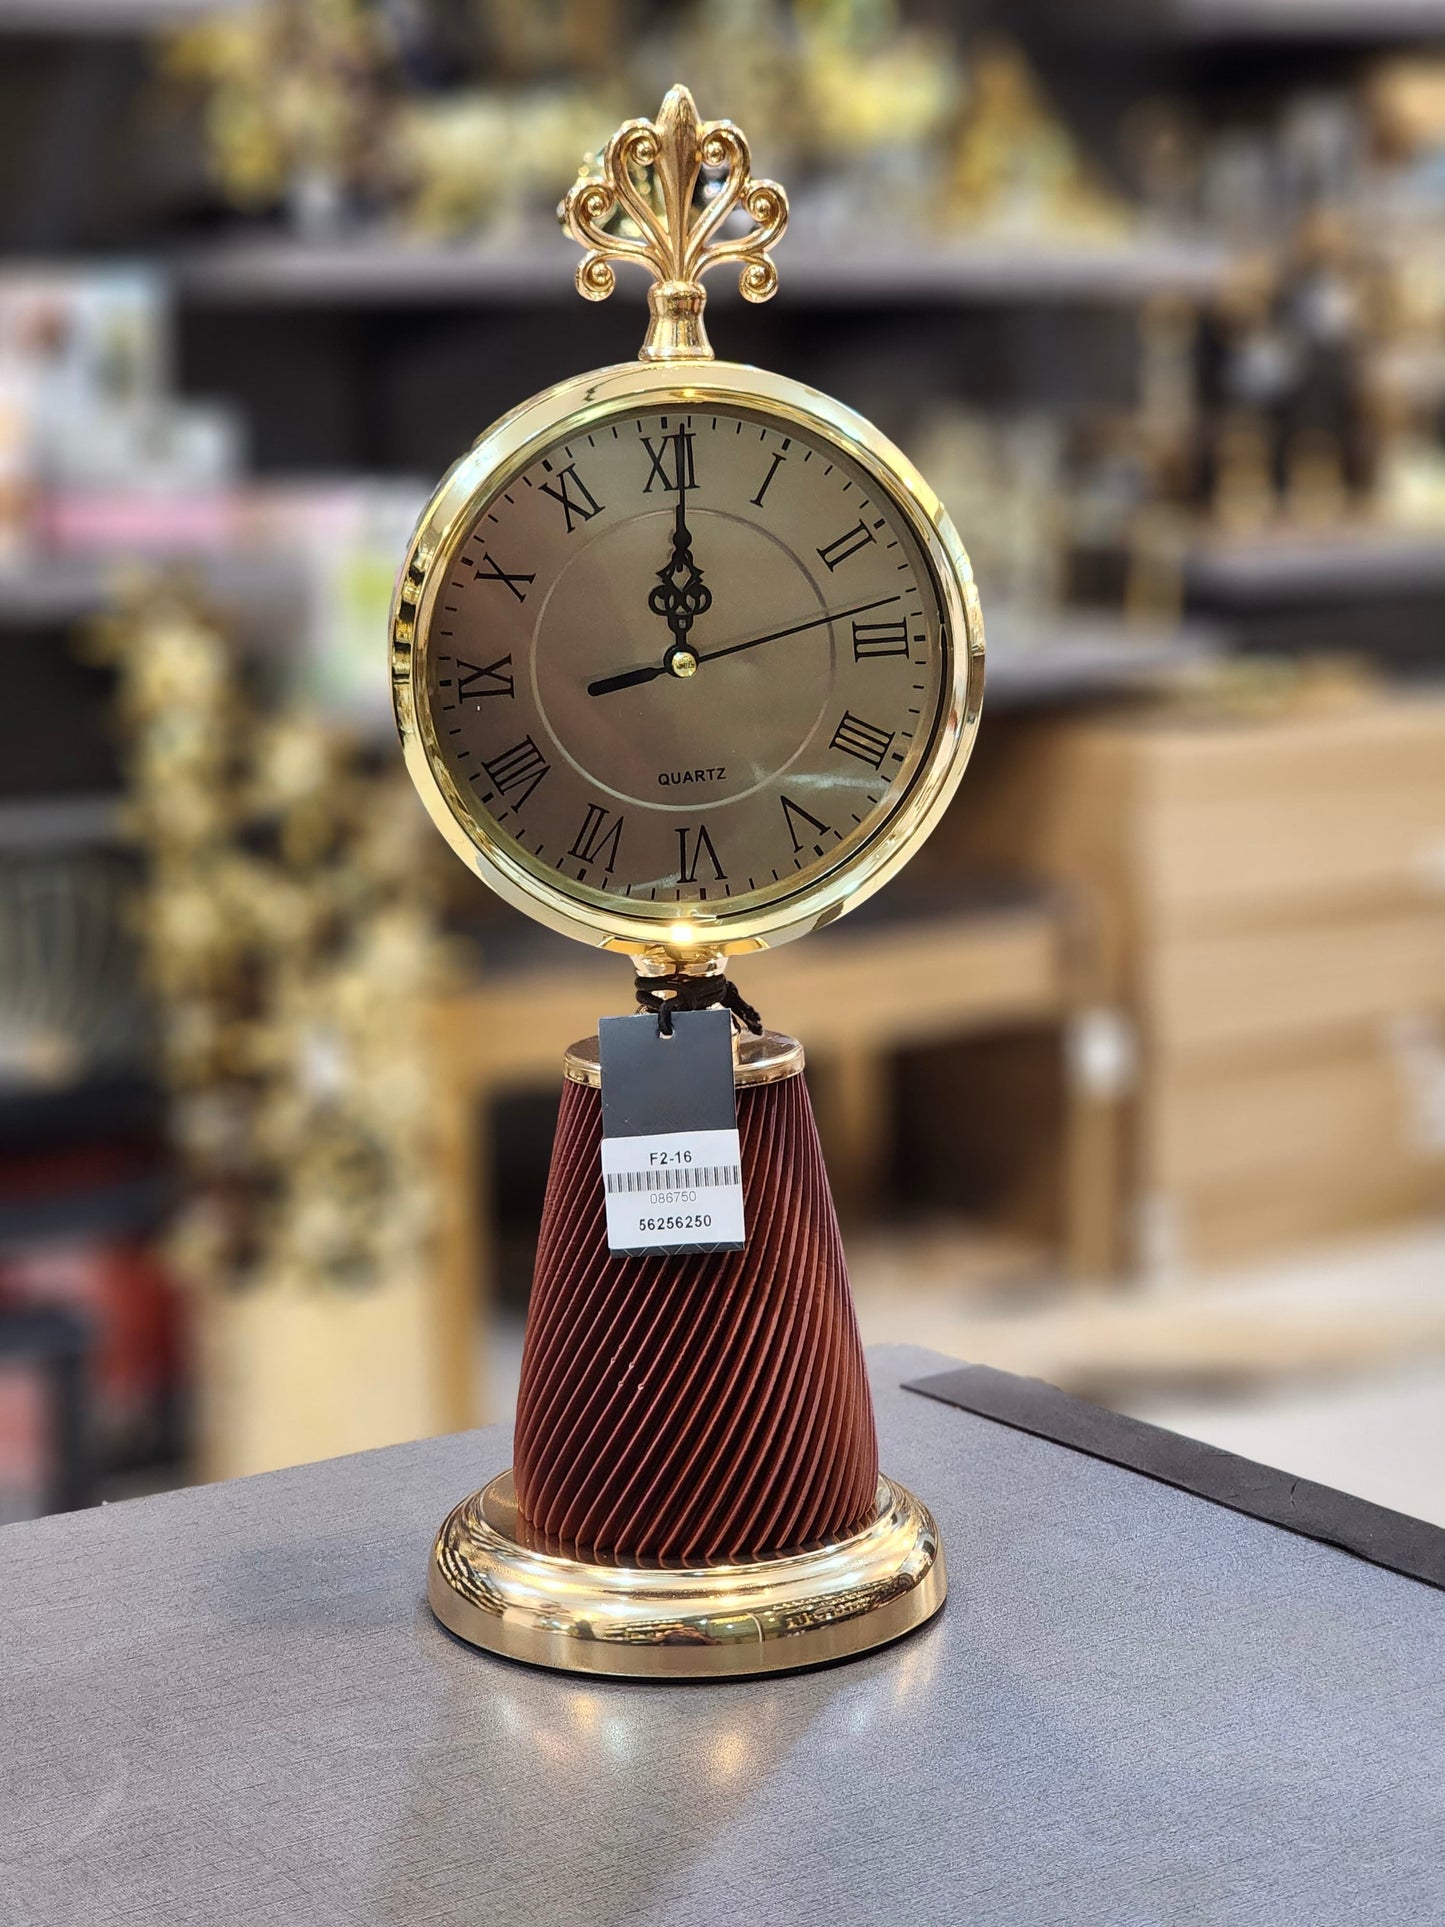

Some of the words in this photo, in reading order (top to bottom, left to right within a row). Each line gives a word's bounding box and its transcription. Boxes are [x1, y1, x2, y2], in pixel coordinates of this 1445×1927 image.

[539, 463, 606, 533] XI
[749, 453, 786, 507] I
[816, 519, 877, 572] II
[473, 553, 536, 603] X
[851, 617, 909, 662] III
[457, 653, 515, 701] IX
[829, 710, 895, 770] IIII
[481, 735, 552, 812] VIII
[657, 767, 727, 786] QUARTZ
[567, 803, 624, 873] VII
[780, 795, 831, 852] V
[674, 825, 728, 883] VI
[650, 1151, 692, 1165] F2-16
[639, 1215, 712, 1231] 56256250
[650, 1191, 697, 1204] 086750
